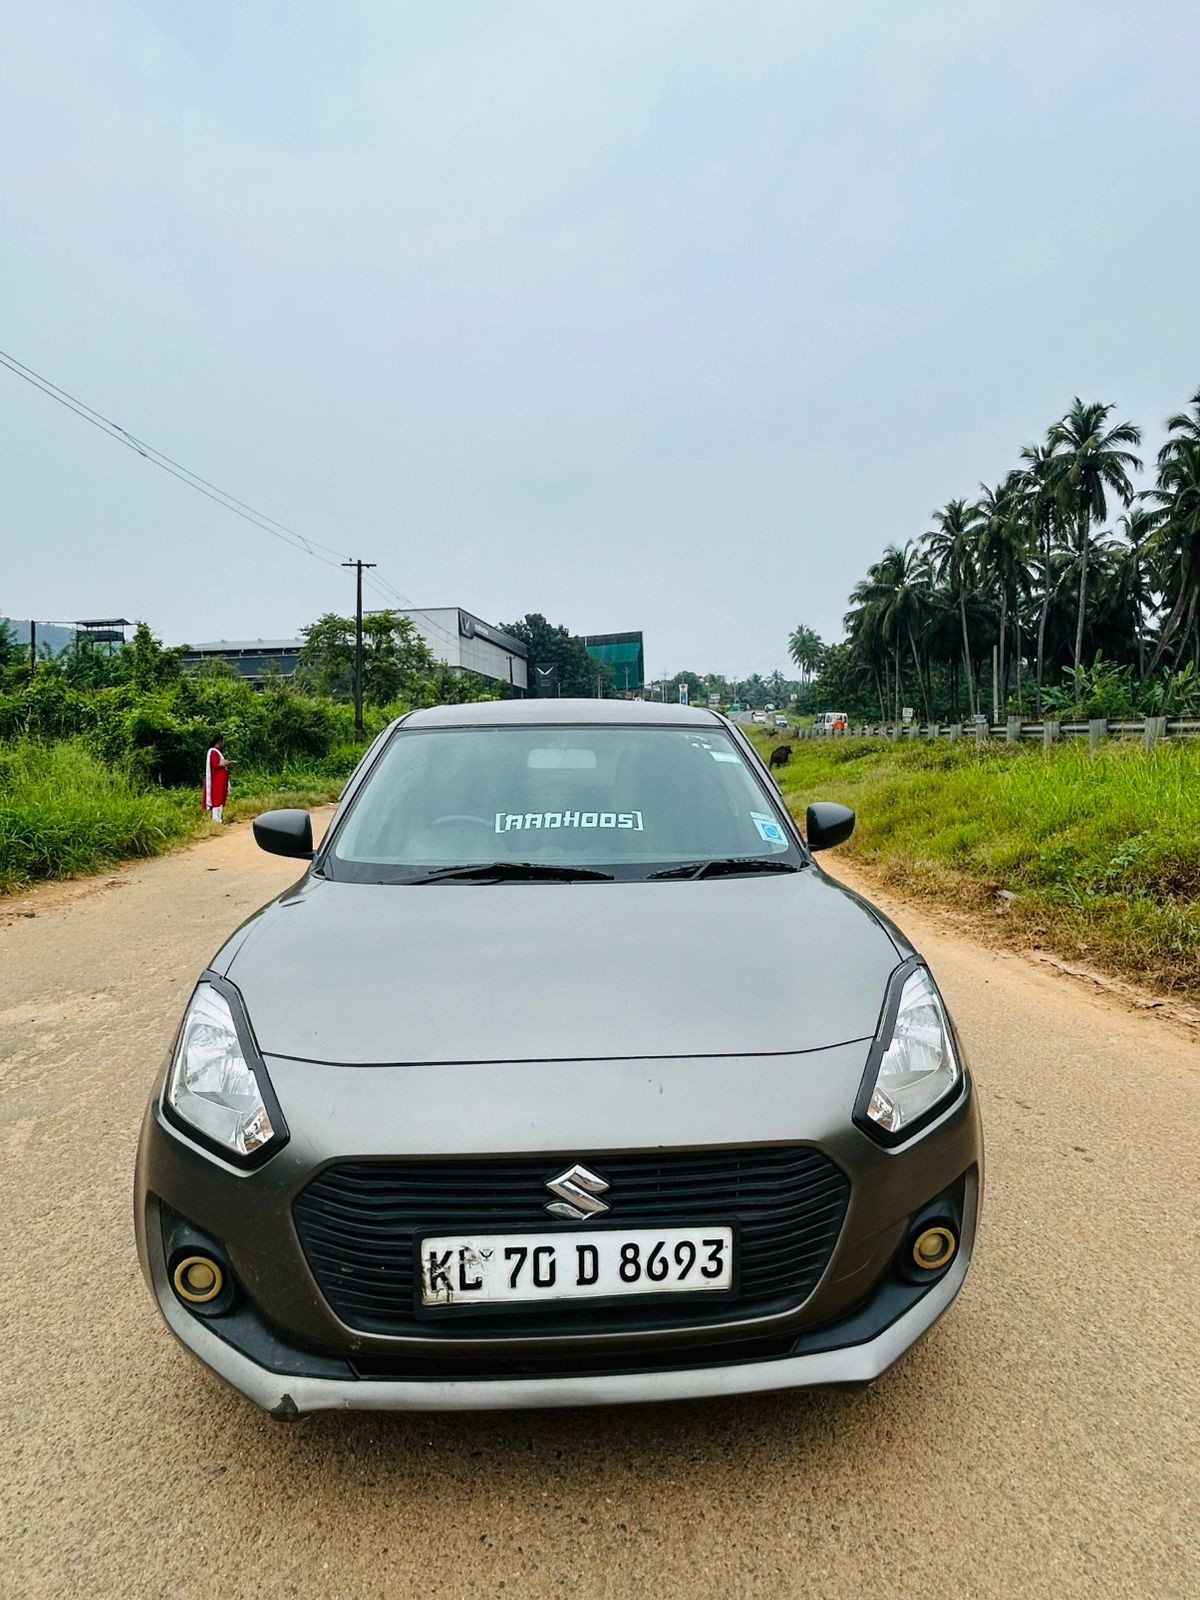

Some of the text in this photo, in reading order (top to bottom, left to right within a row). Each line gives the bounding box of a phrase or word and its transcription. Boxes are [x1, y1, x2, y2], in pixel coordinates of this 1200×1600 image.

[428, 1239, 724, 1292] KL 70 D 8693
